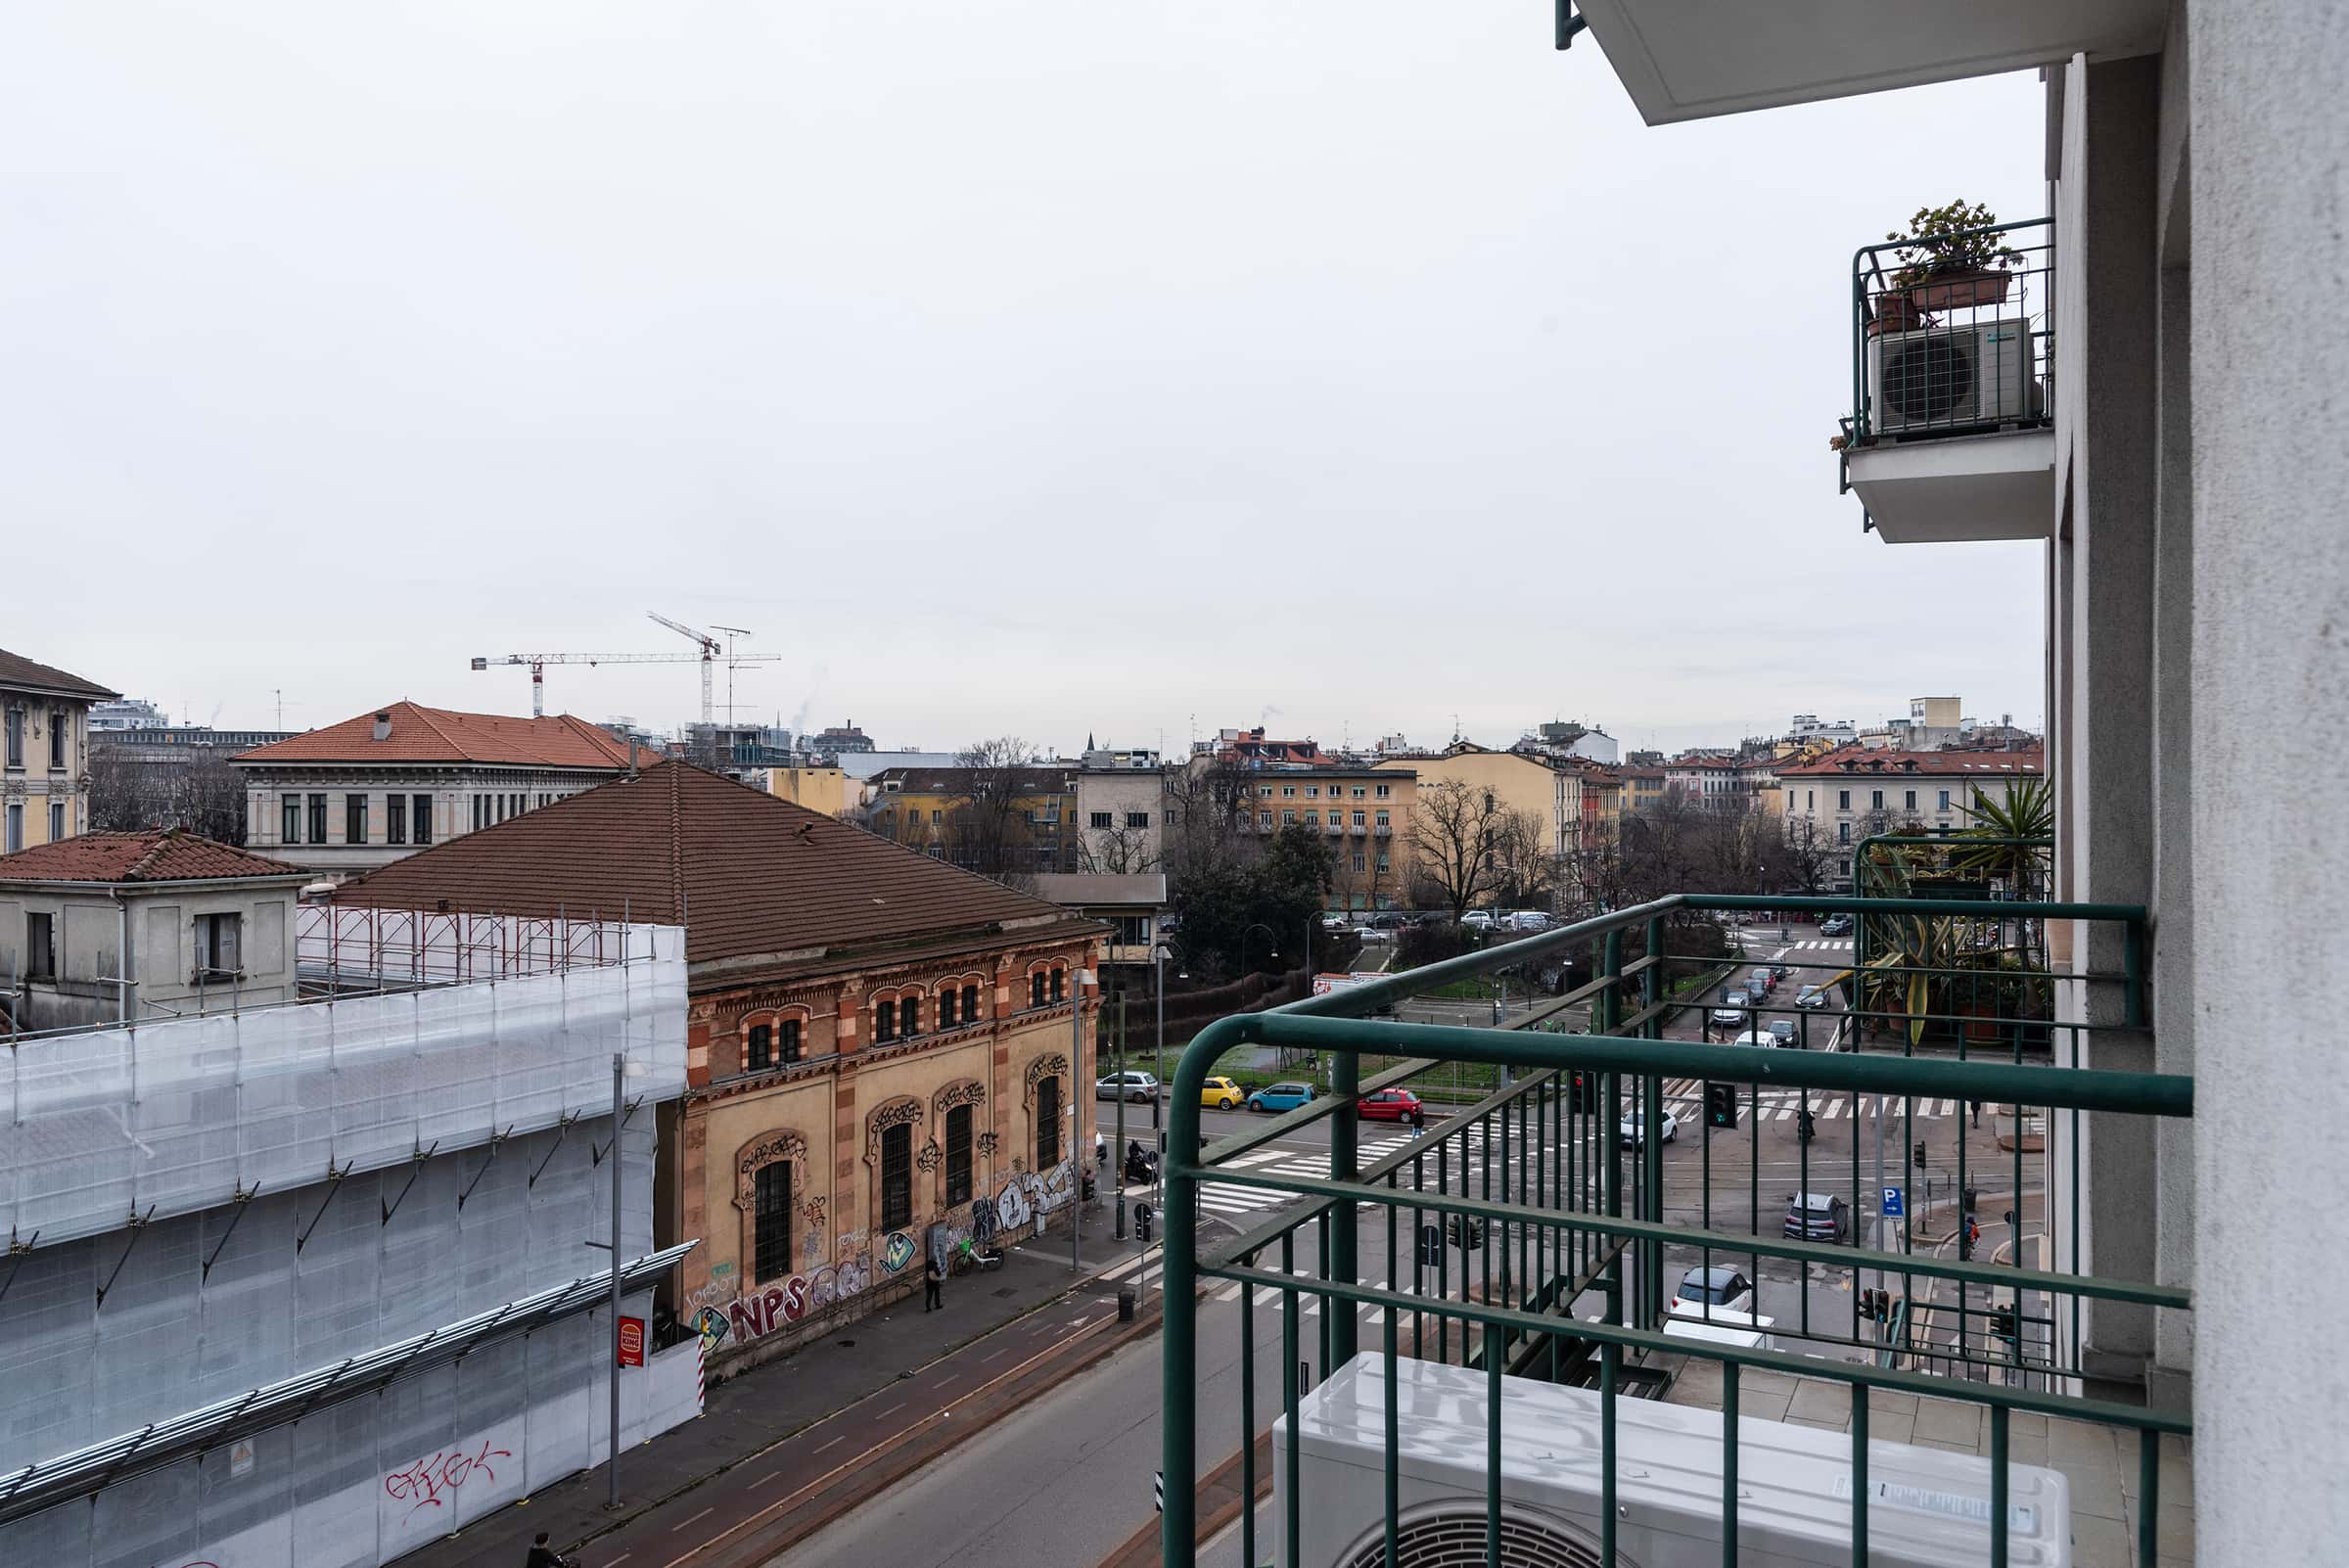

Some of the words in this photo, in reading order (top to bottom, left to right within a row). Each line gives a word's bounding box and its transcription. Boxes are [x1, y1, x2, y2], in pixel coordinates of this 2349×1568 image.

[1884, 1189, 1896, 1203] P
[728, 1275, 808, 1344] NPS
[622, 1337, 640, 1348] KING
